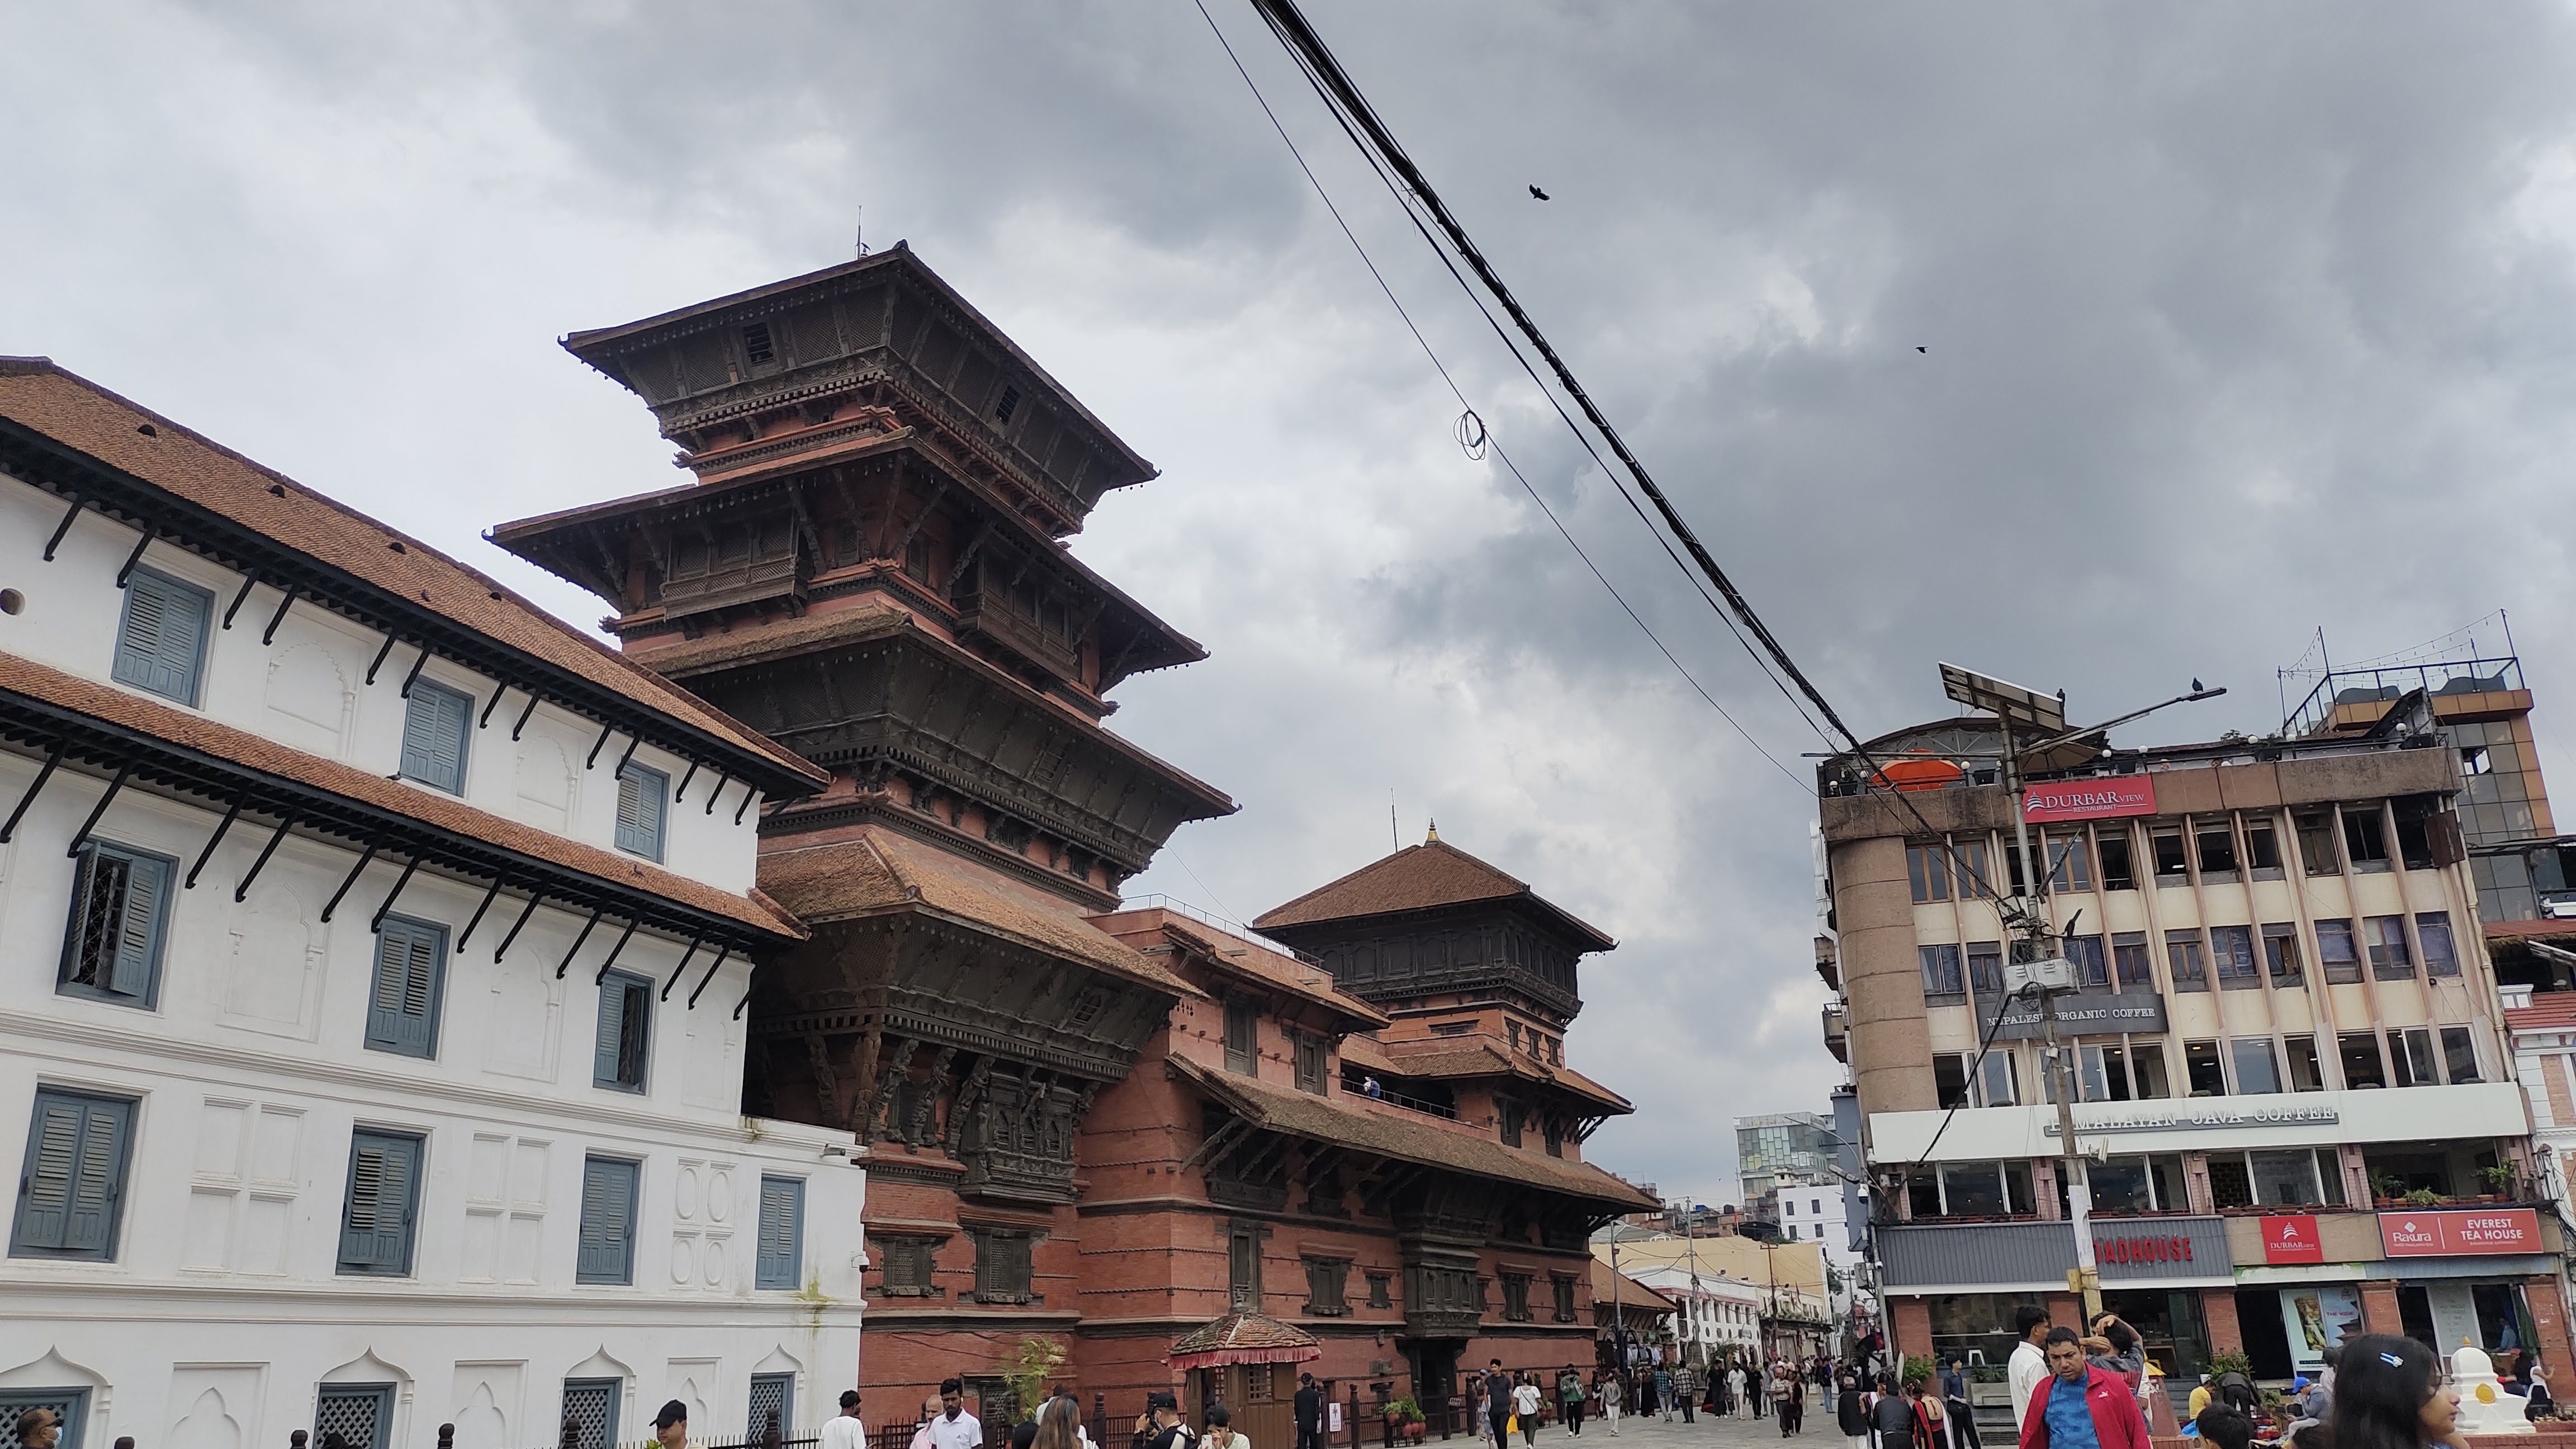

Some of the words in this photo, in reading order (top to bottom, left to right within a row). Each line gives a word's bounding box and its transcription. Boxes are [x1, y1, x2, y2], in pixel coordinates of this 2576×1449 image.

[2044, 792, 2120, 808] DURBAR
[2119, 794, 2144, 802] VIEW
[2073, 804, 2116, 813] RESTAURANT
[2113, 1008, 2155, 1019] COFFEE
[2049, 1112, 2177, 1131] HMALAYAN
[2191, 1110, 2244, 1125] JAVA
[2253, 1106, 2335, 1121] COFFEE
[2467, 1219, 2512, 1229] EVEREST
[2393, 1232, 2432, 1242] Rakura
[2460, 1230, 2482, 1240] TEA
[2485, 1229, 2523, 1240] HOUSE
[2092, 1237, 2193, 1264] OADHOUSE
